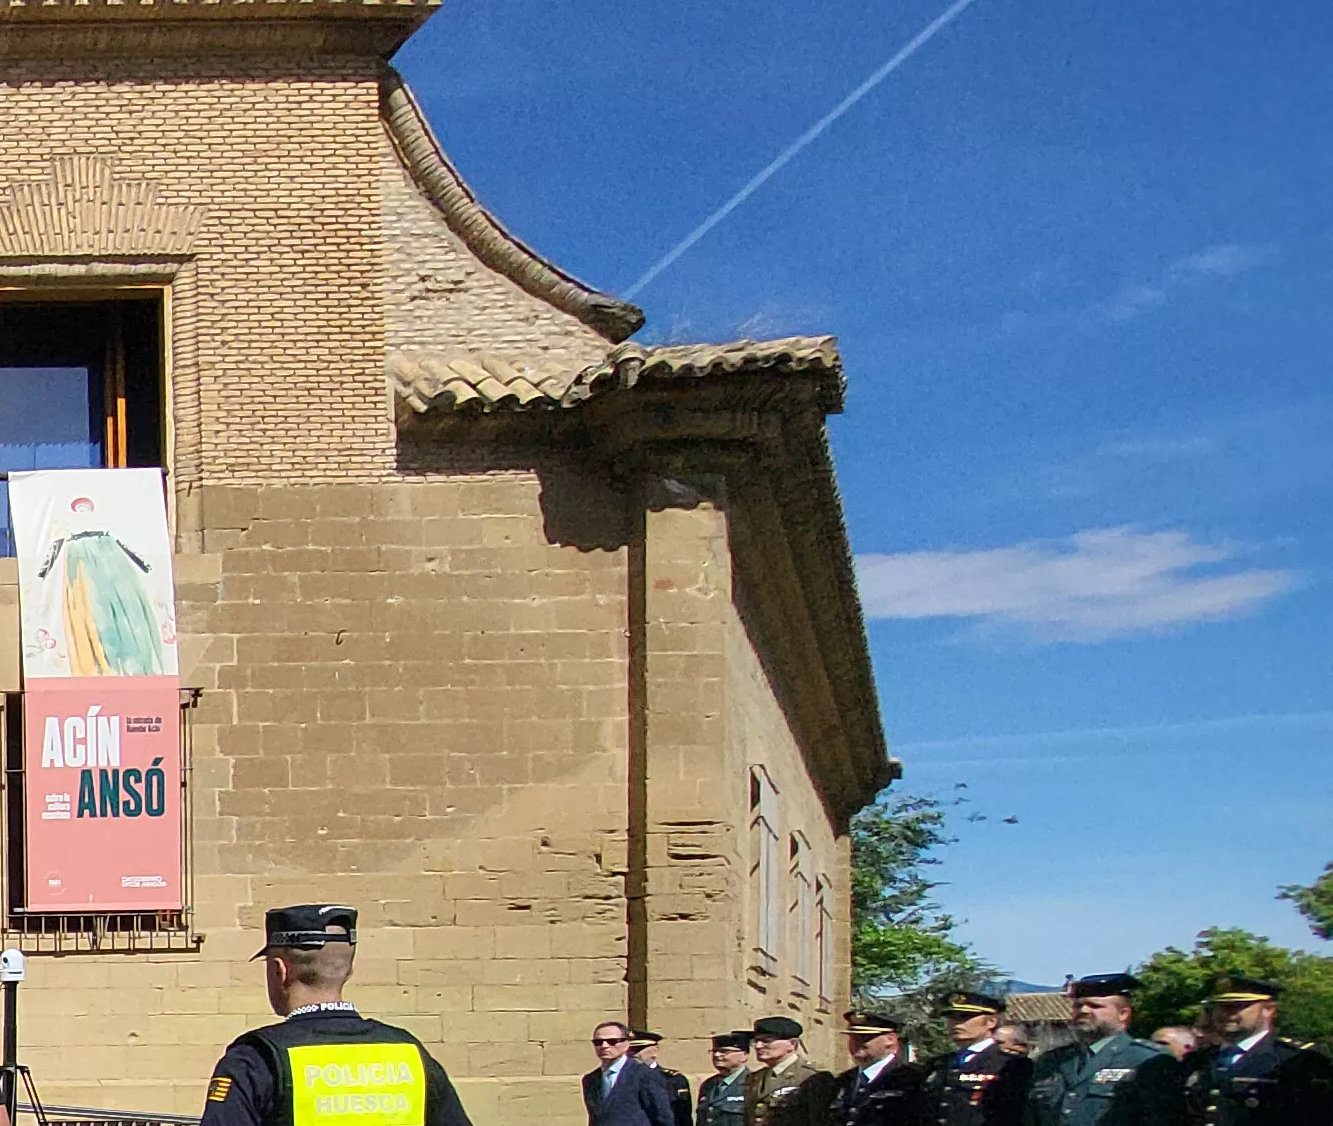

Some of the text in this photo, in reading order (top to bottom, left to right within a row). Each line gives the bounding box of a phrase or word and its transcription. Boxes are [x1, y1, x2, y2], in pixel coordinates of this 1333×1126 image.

[41, 705, 121, 768] ACÍN
[77, 756, 165, 819] ANSÓ
[304, 1061, 414, 1088] POLICIA
[315, 1093, 410, 1115] HUESCA
